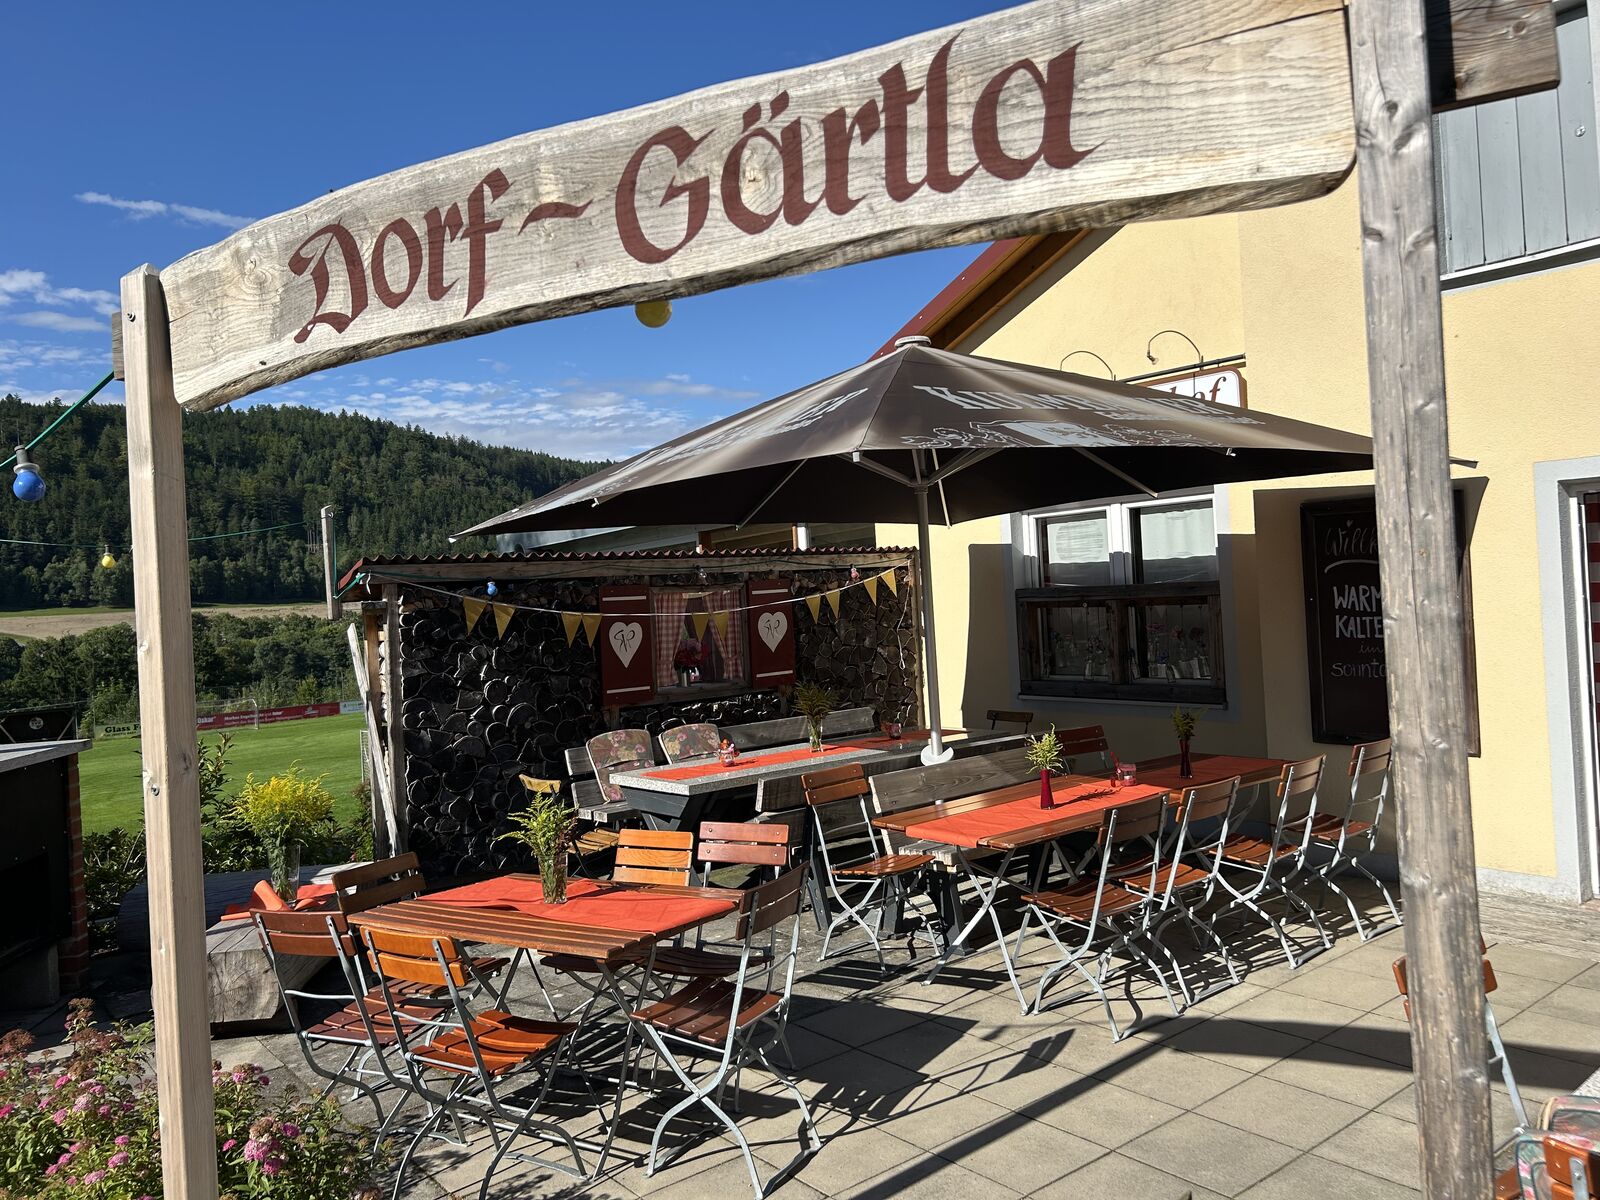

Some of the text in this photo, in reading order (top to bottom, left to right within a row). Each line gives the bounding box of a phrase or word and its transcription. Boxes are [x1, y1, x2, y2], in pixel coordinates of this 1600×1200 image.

[288, 167, 515, 343] Dorf
[615, 28, 1105, 264] Gärtla
[912, 385, 1235, 416] KULMBAHER
[1335, 614, 1384, 639] KALTE
[104, 725, 131, 734] Glass
